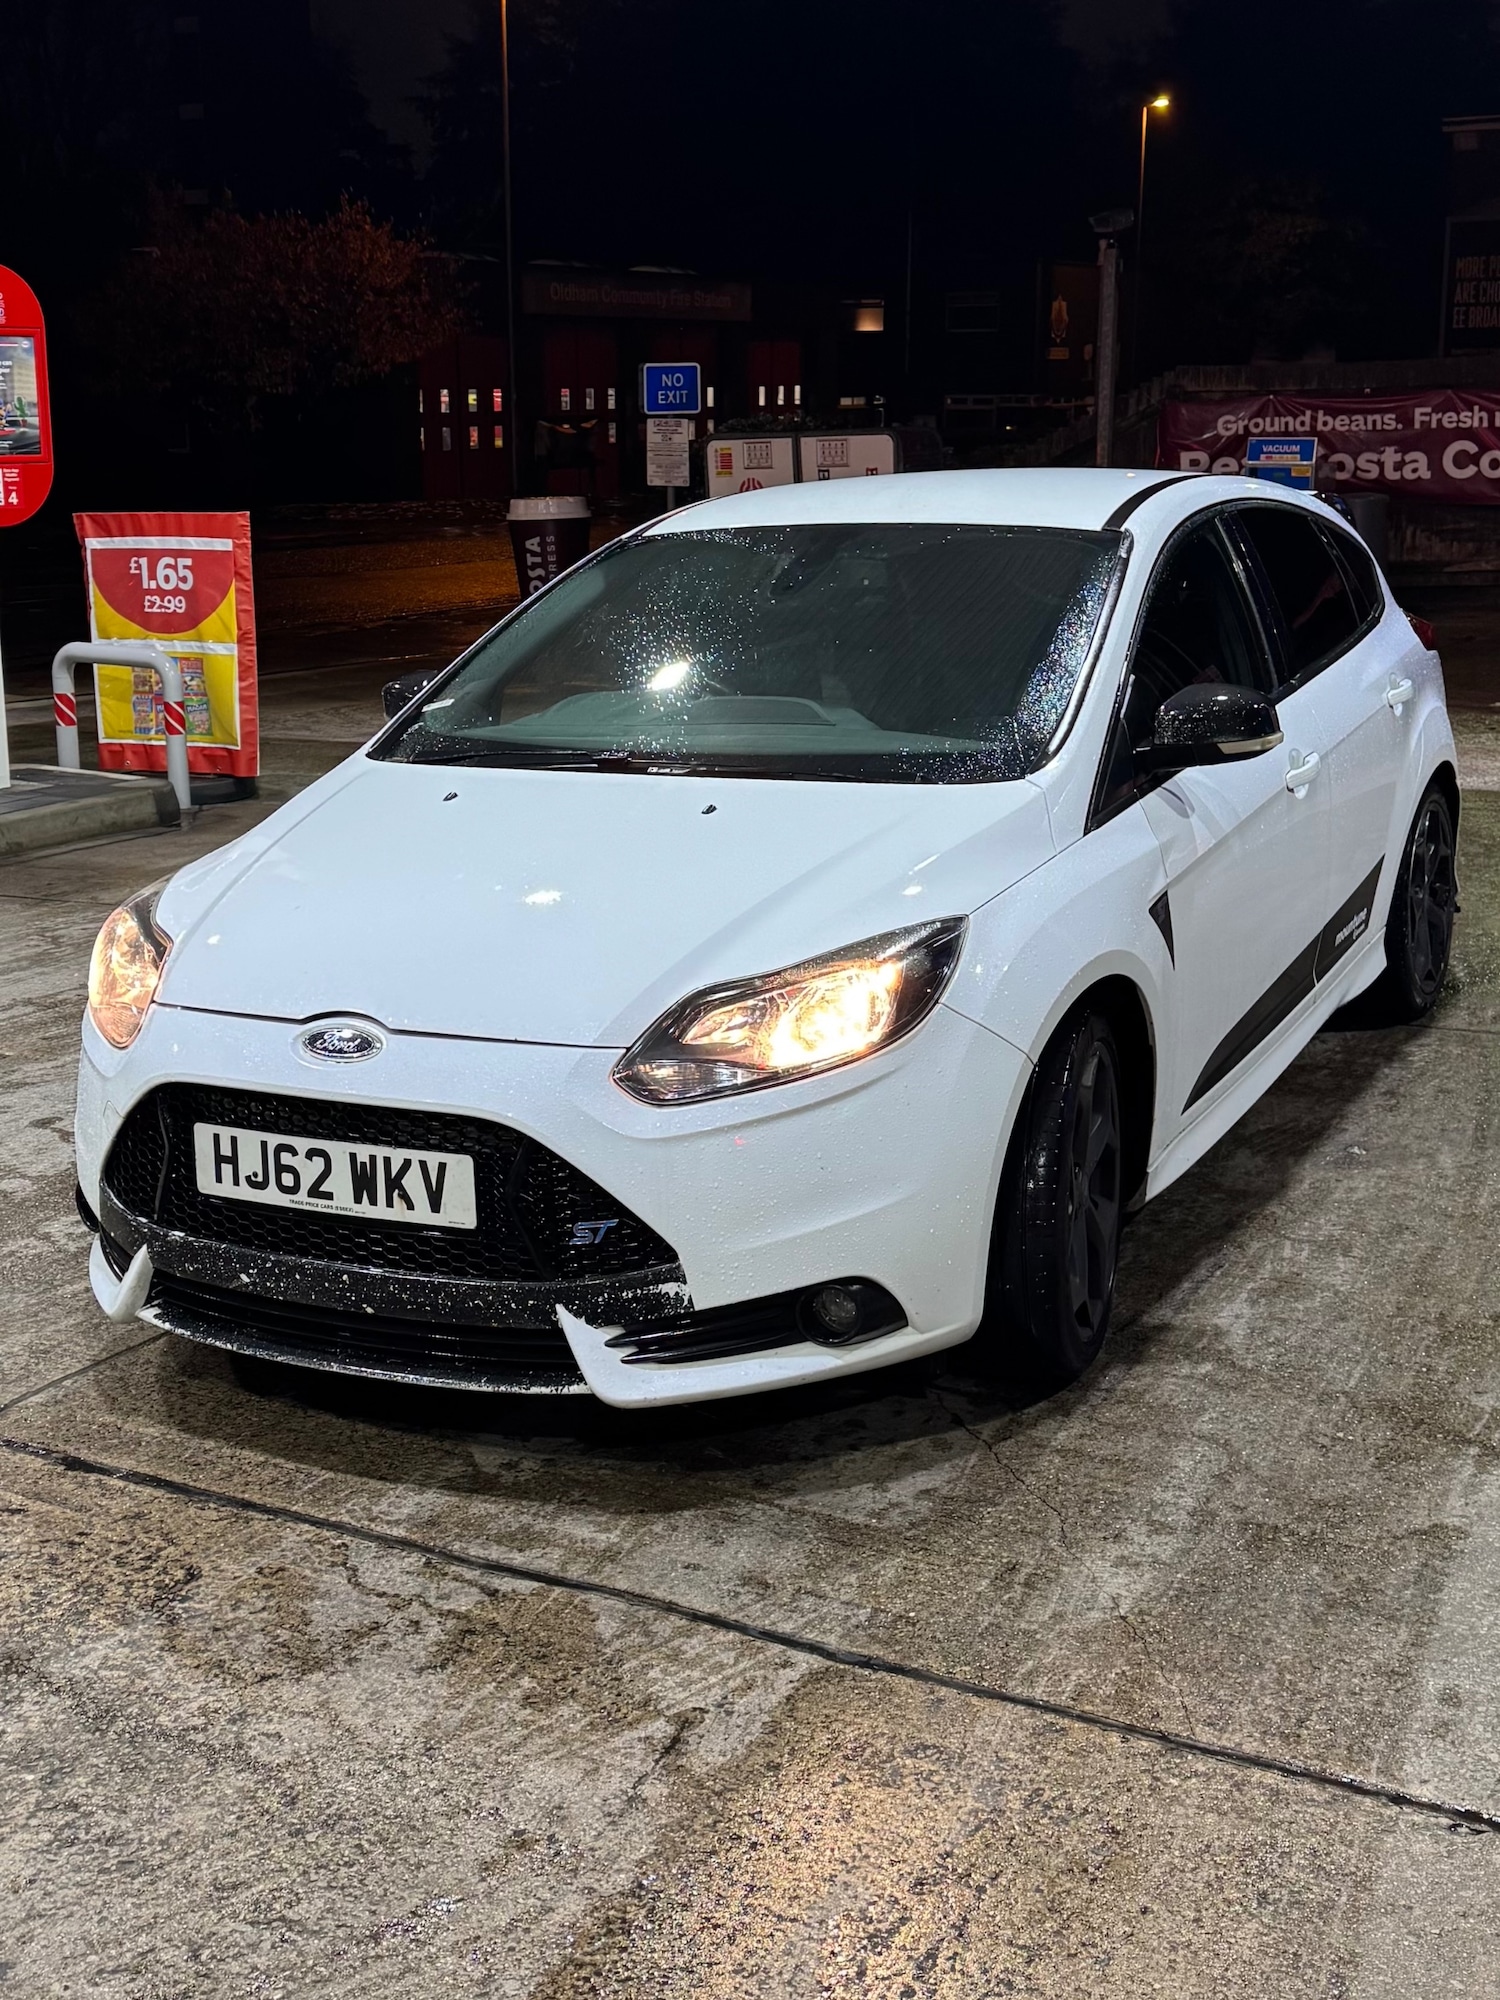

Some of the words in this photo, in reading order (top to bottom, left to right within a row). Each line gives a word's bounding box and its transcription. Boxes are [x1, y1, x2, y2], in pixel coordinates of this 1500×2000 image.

[1455, 256, 1486, 279] MORE
[550, 282, 599, 302] Oldham
[601, 284, 667, 309] Community
[670, 289, 691, 306] Fire
[694, 291, 732, 308] Station
[1454, 281, 1478, 304] ARE
[1452, 306, 1466, 328] EE
[661, 373, 684, 387] NO
[657, 390, 688, 404] EXIT
[1217, 410, 1312, 436] Ground
[1316, 410, 1403, 432] beans.
[1413, 405, 1489, 429] Fresh
[1262, 445, 1300, 453] VACUUM
[1316, 444, 1432, 480] osta
[1442, 440, 1500, 480] Co
[8, 491, 19, 506] 4
[129, 556, 194, 591] £1.65
[143, 595, 186, 614] £2.99
[314, 1031, 362, 1052] Ford
[212, 1132, 334, 1201] HJ62
[349, 1151, 448, 1214] WKV
[569, 1219, 619, 1244] ST
